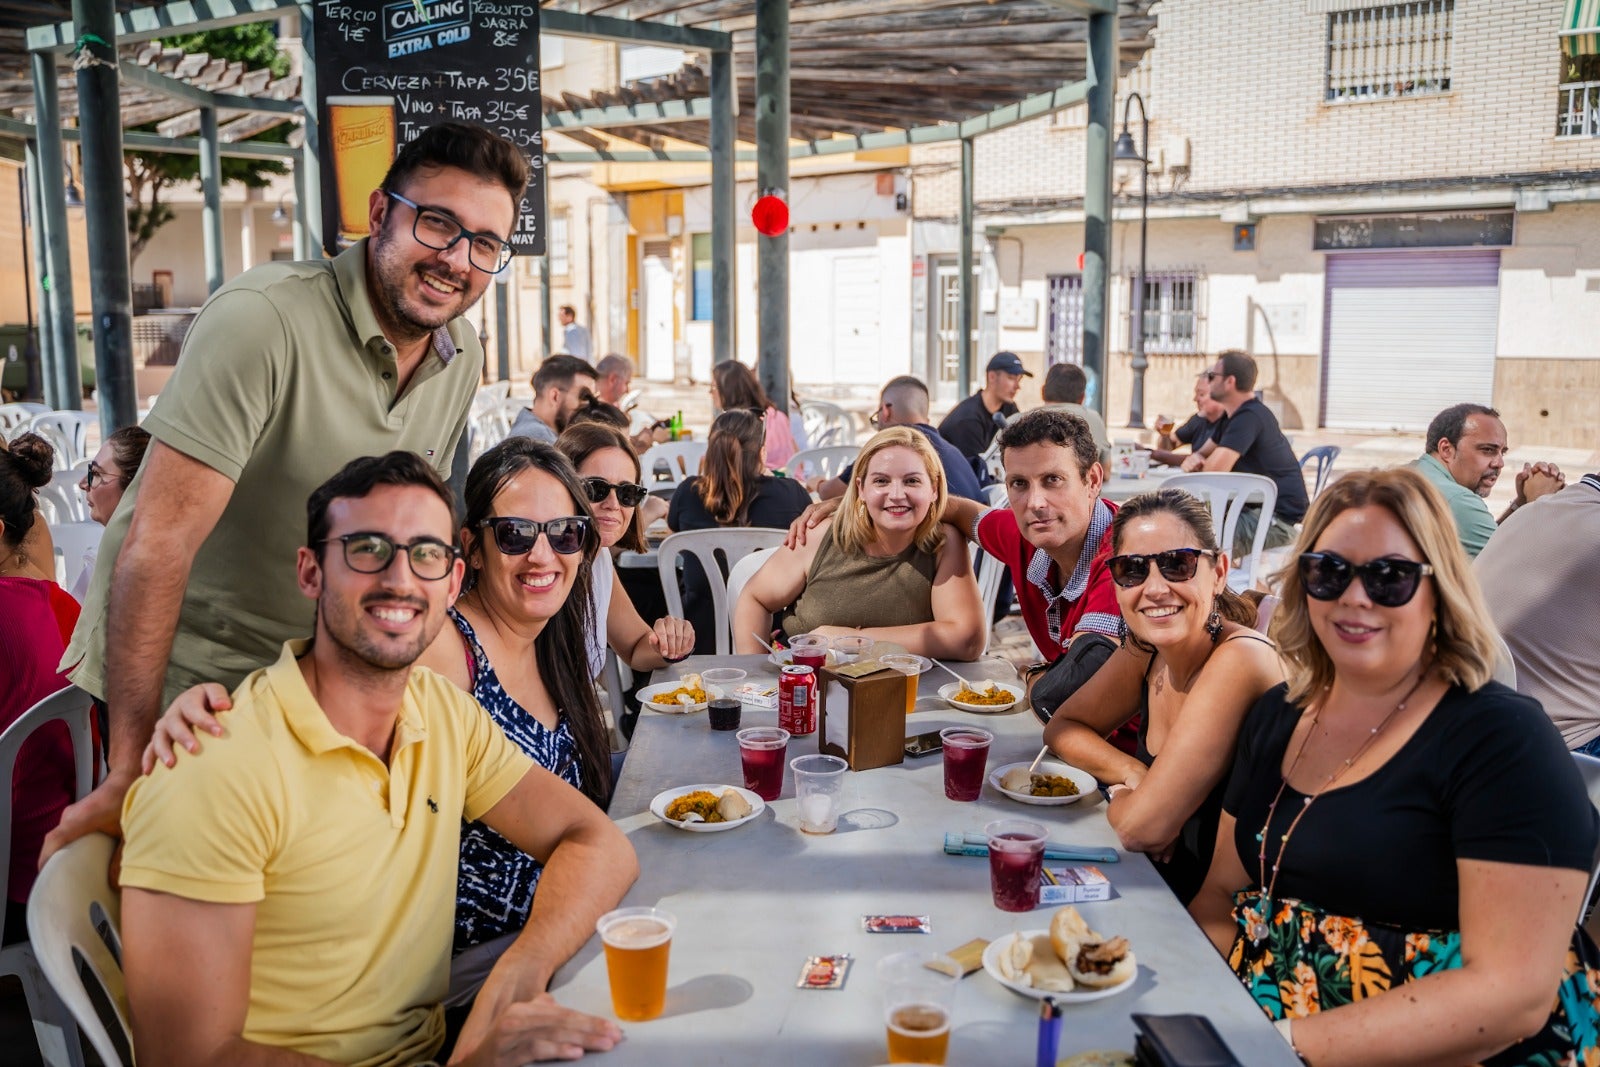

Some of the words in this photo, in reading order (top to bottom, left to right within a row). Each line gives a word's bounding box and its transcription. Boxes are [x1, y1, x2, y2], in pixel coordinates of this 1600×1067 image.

[391, 0, 464, 29] CARLING
[480, 17, 528, 30] JARRA
[338, 22, 370, 42] 4€
[388, 35, 433, 59] EXTRA
[437, 26, 471, 46] COLD
[493, 30, 519, 47] 8€
[342, 66, 431, 92] CERVEZA
[443, 71, 490, 90] TAPA
[397, 94, 434, 114] VINO
[446, 101, 481, 120] TAPA
